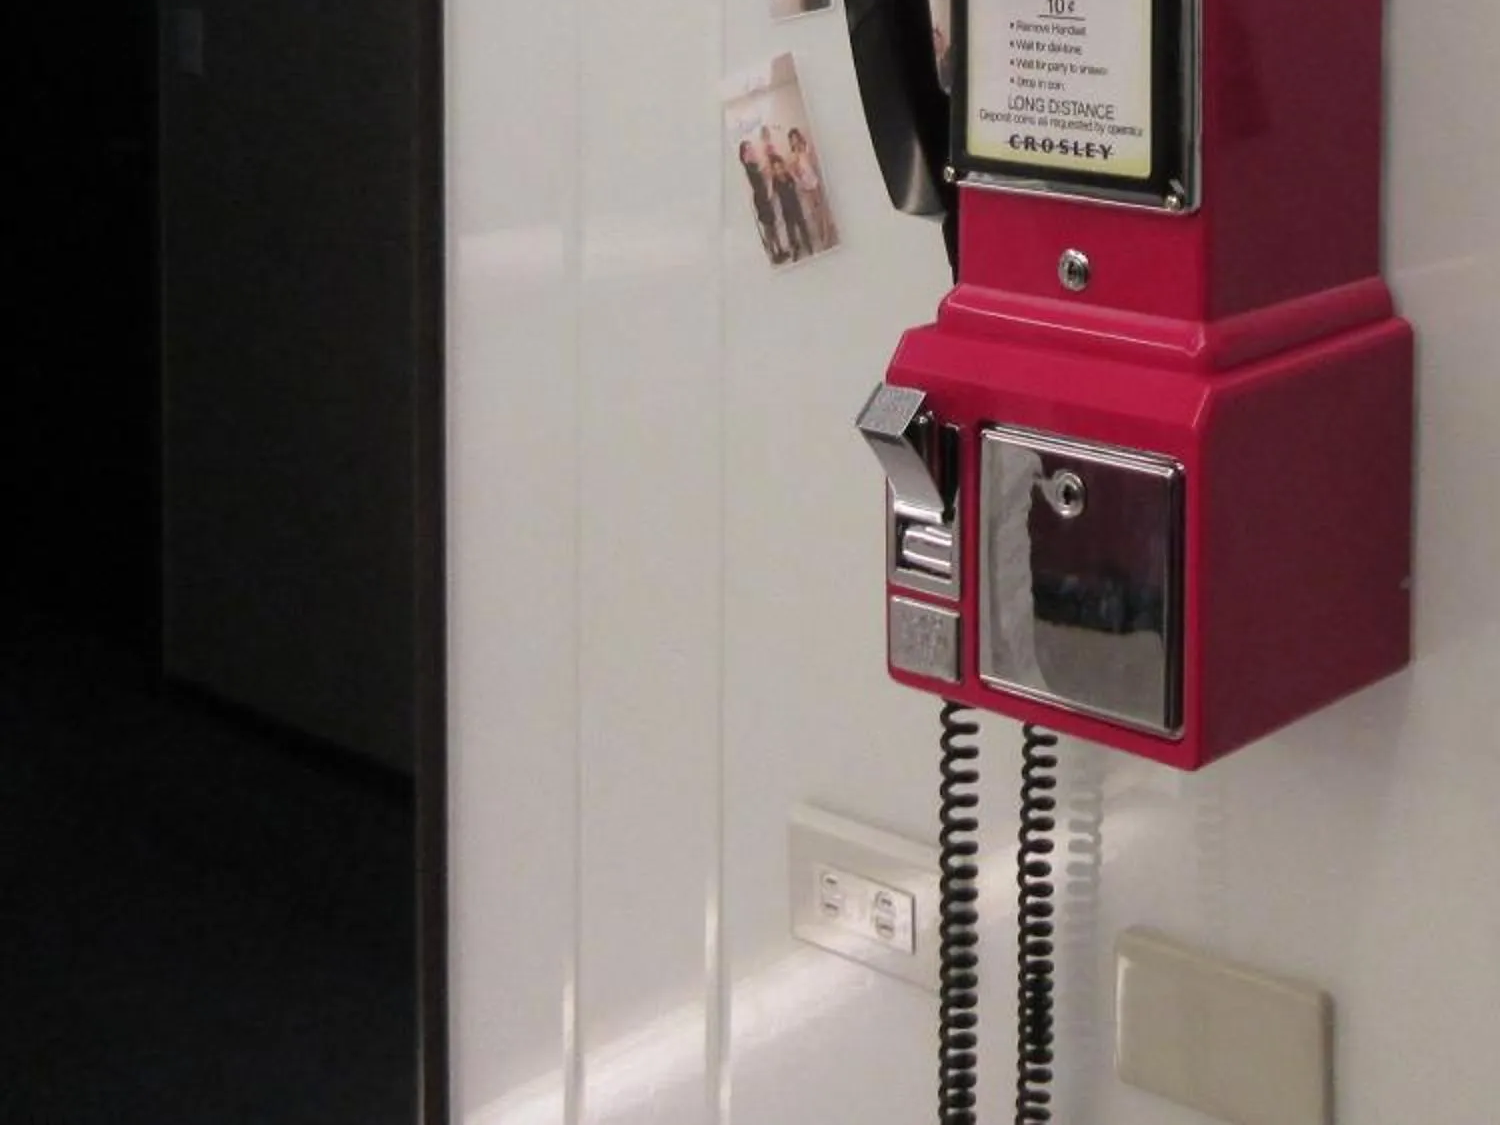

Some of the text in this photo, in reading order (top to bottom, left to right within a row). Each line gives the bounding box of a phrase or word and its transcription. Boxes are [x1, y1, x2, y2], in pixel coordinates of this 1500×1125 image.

[1016, 39, 1034, 51] Wait
[1036, 41, 1046, 52] for
[1016, 58, 1034, 70] Wait
[1036, 59, 1046, 70] for
[1008, 95, 1115, 120] LONG DISTANCE
[979, 109, 1012, 122] Deposit
[1007, 133, 1113, 160] CROSLEY
